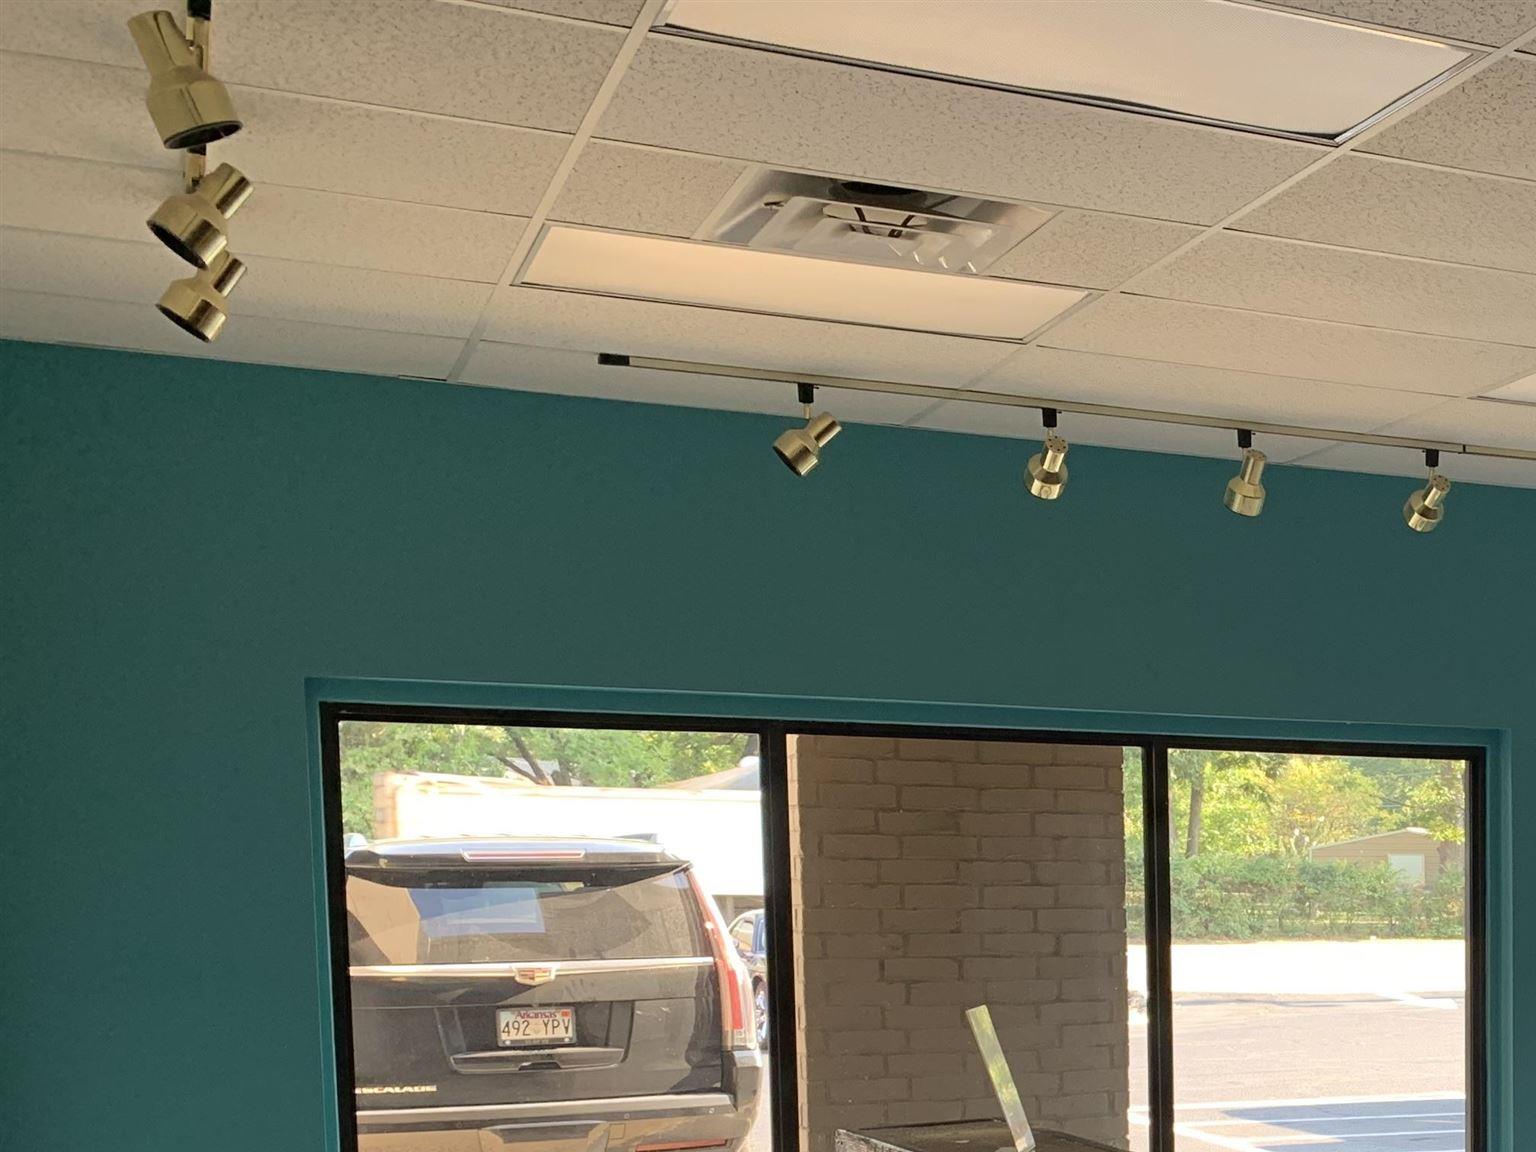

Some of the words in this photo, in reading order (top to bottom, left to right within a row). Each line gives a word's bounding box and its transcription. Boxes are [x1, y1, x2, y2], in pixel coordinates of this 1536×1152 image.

[516, 1010, 558, 1019] Arkansas
[502, 1019, 531, 1037] 492
[542, 1018, 571, 1036] YPV
